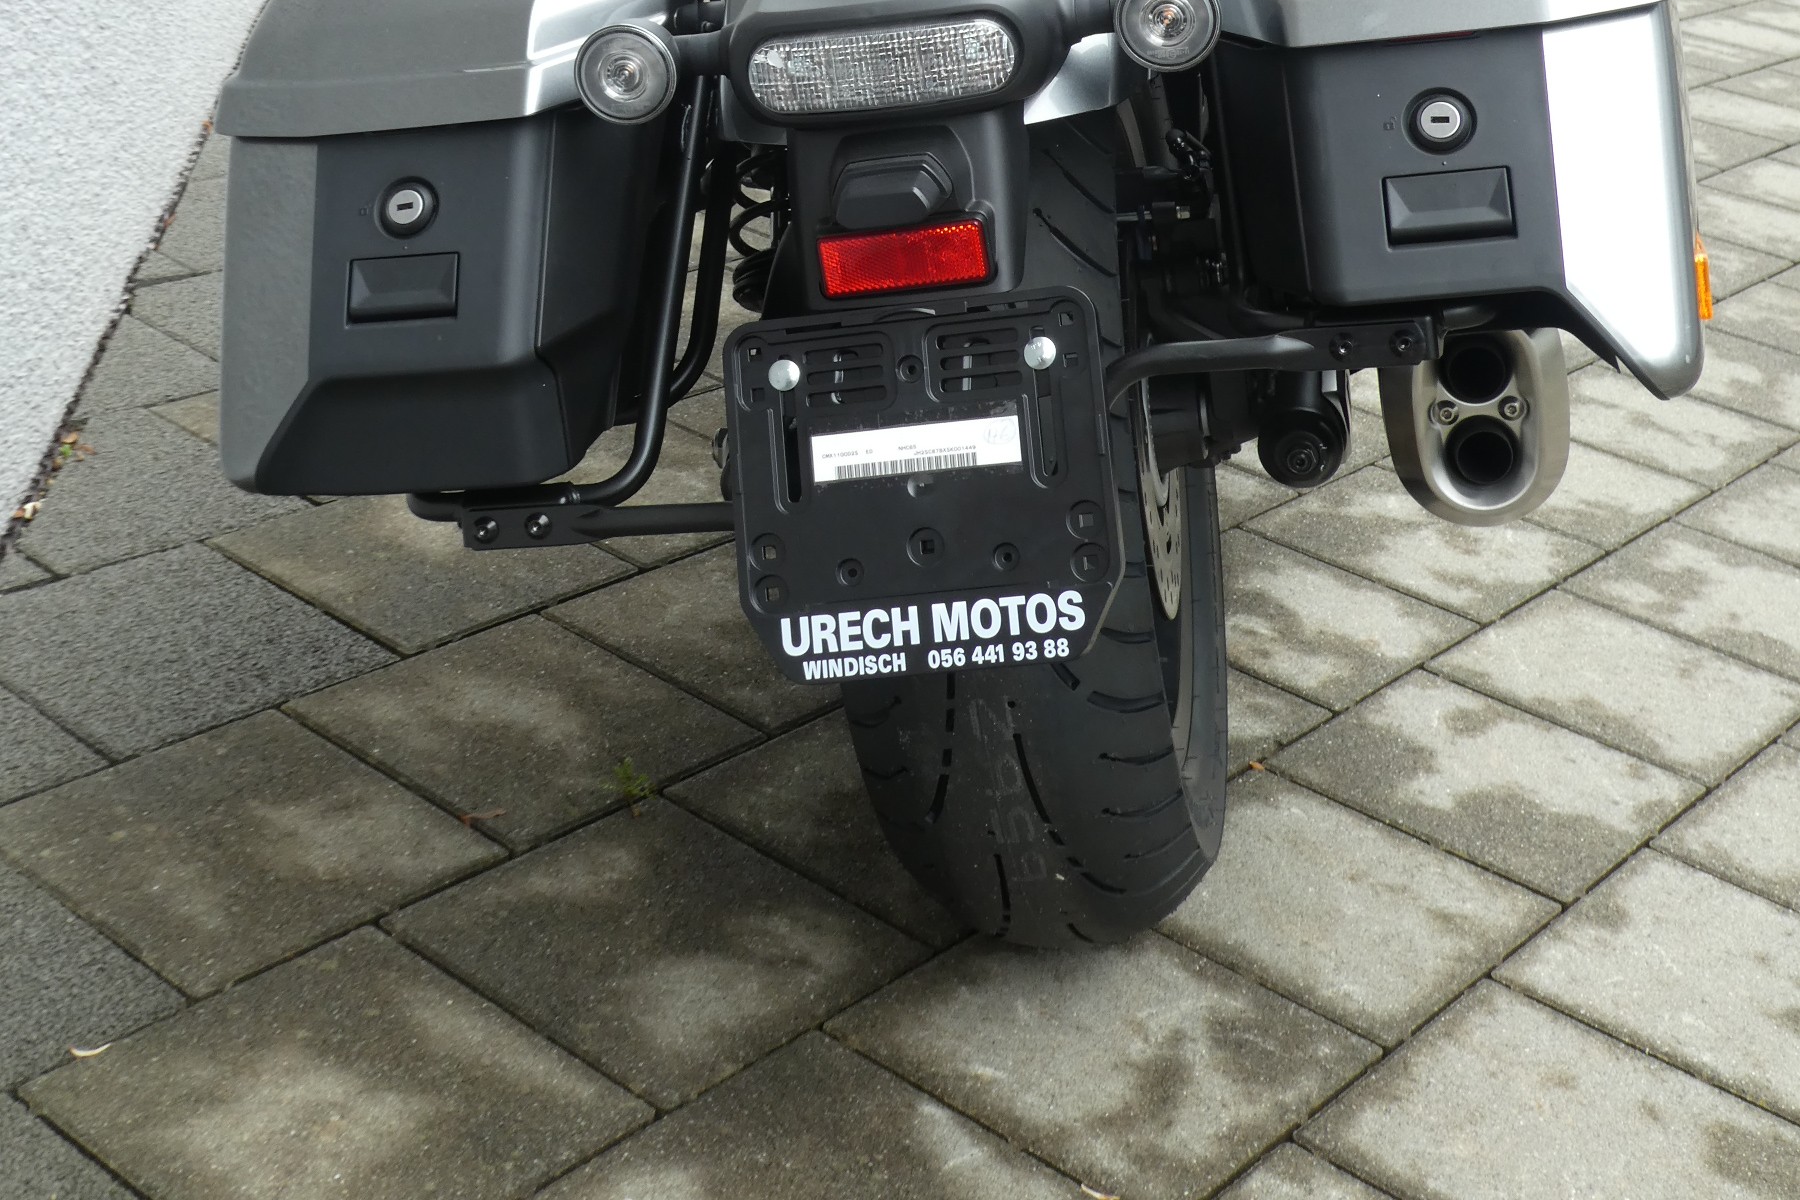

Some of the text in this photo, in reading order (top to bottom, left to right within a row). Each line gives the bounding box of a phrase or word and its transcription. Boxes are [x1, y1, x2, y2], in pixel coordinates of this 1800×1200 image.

[780, 590, 1087, 658] URECH MOTOS
[802, 637, 1070, 681] WINDISCH 056 441 93 88
